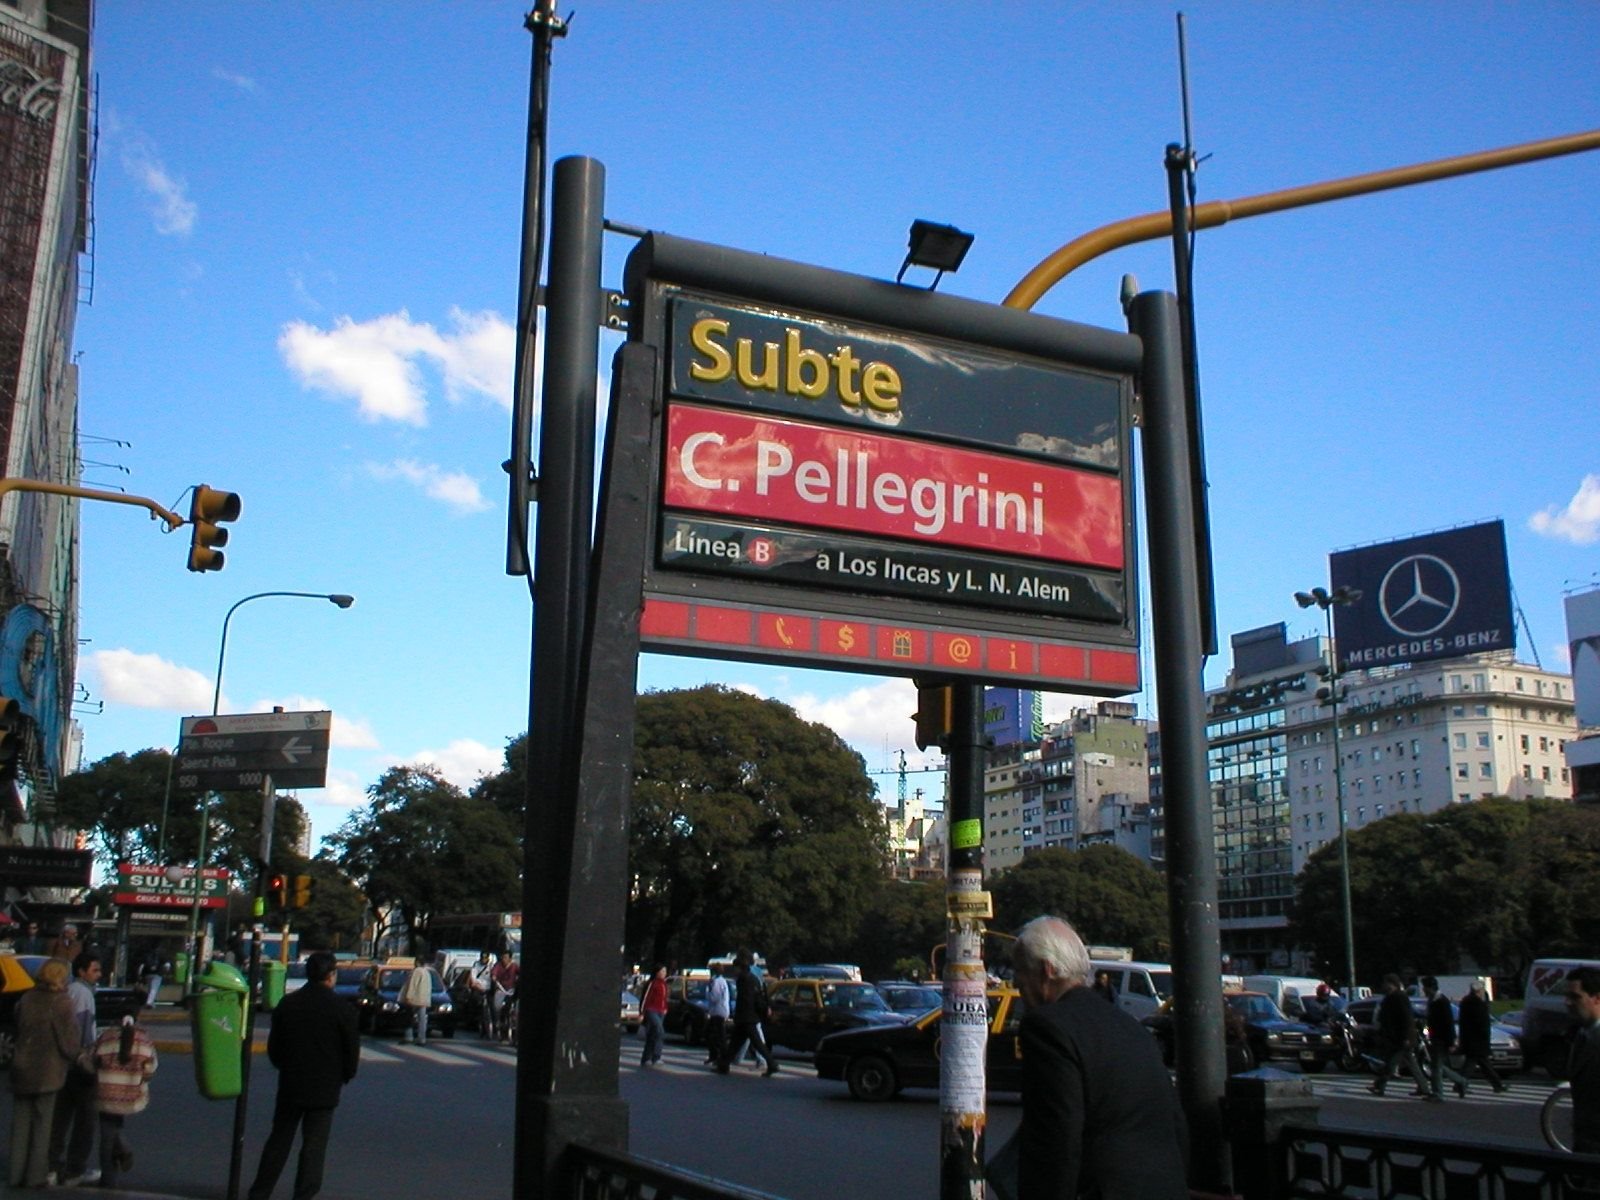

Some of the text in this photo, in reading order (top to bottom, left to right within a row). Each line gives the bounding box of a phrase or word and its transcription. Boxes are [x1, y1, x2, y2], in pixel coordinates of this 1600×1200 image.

[689, 318, 902, 411] Subte
[680, 432, 1044, 536] C. Pellegrini
[675, 530, 1070, 602] Línea B a Los Incas y L. N. Alem
[1350, 629, 1500, 663] MERCEDES-BENZ
[238, 772, 262, 786] 1000
[953, 1002, 985, 1014] UBA
